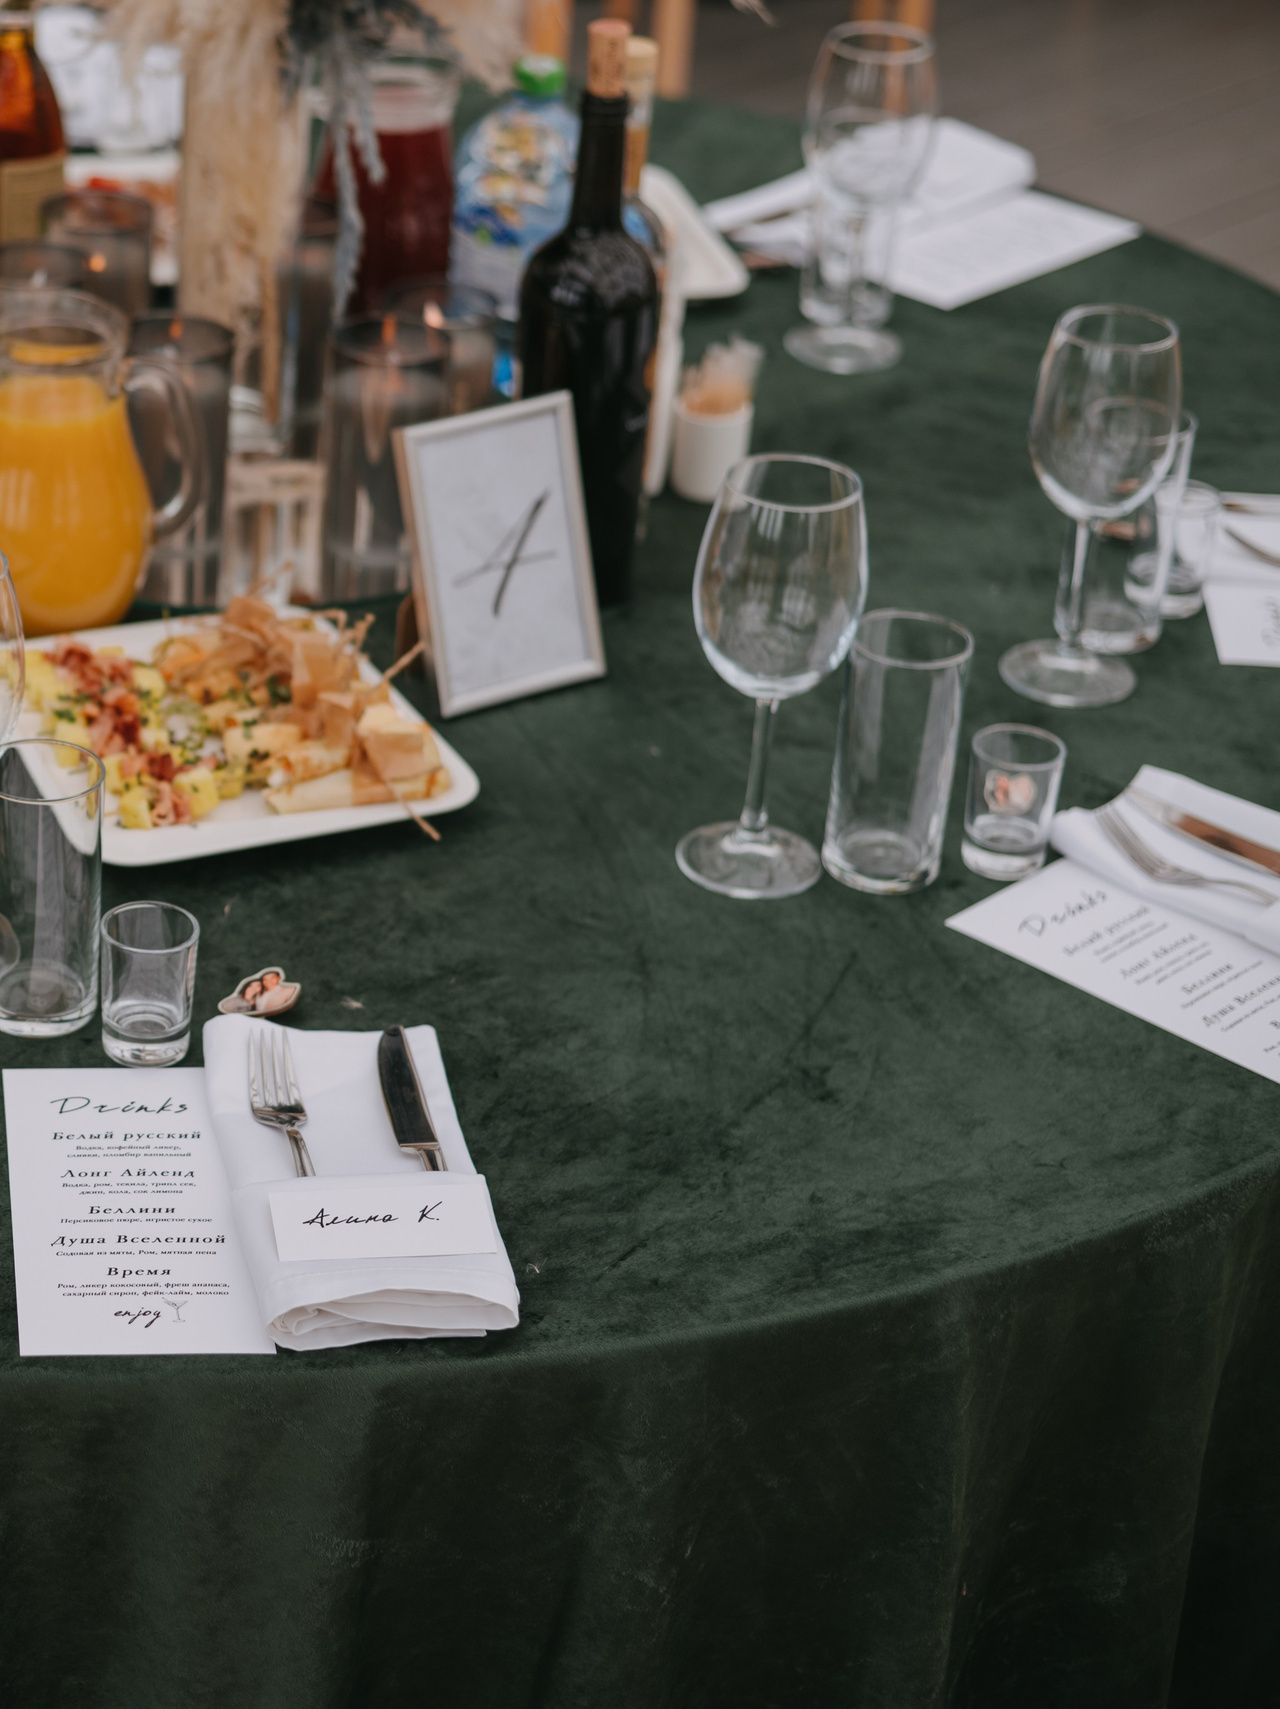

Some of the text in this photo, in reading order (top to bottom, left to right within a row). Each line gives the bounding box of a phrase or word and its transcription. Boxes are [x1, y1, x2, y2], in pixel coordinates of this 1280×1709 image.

[50, 1096, 188, 1114] Drinks
[52, 1131, 201, 1141] Белый русский
[61, 1169, 194, 1178] Лонг Айленд
[88, 1206, 175, 1214] Беллини
[302, 1201, 443, 1229] Алина К.
[51, 1235, 226, 1247] Душа Вселенной
[106, 1267, 171, 1278] Время
[114, 1307, 161, 1328] enjoy
